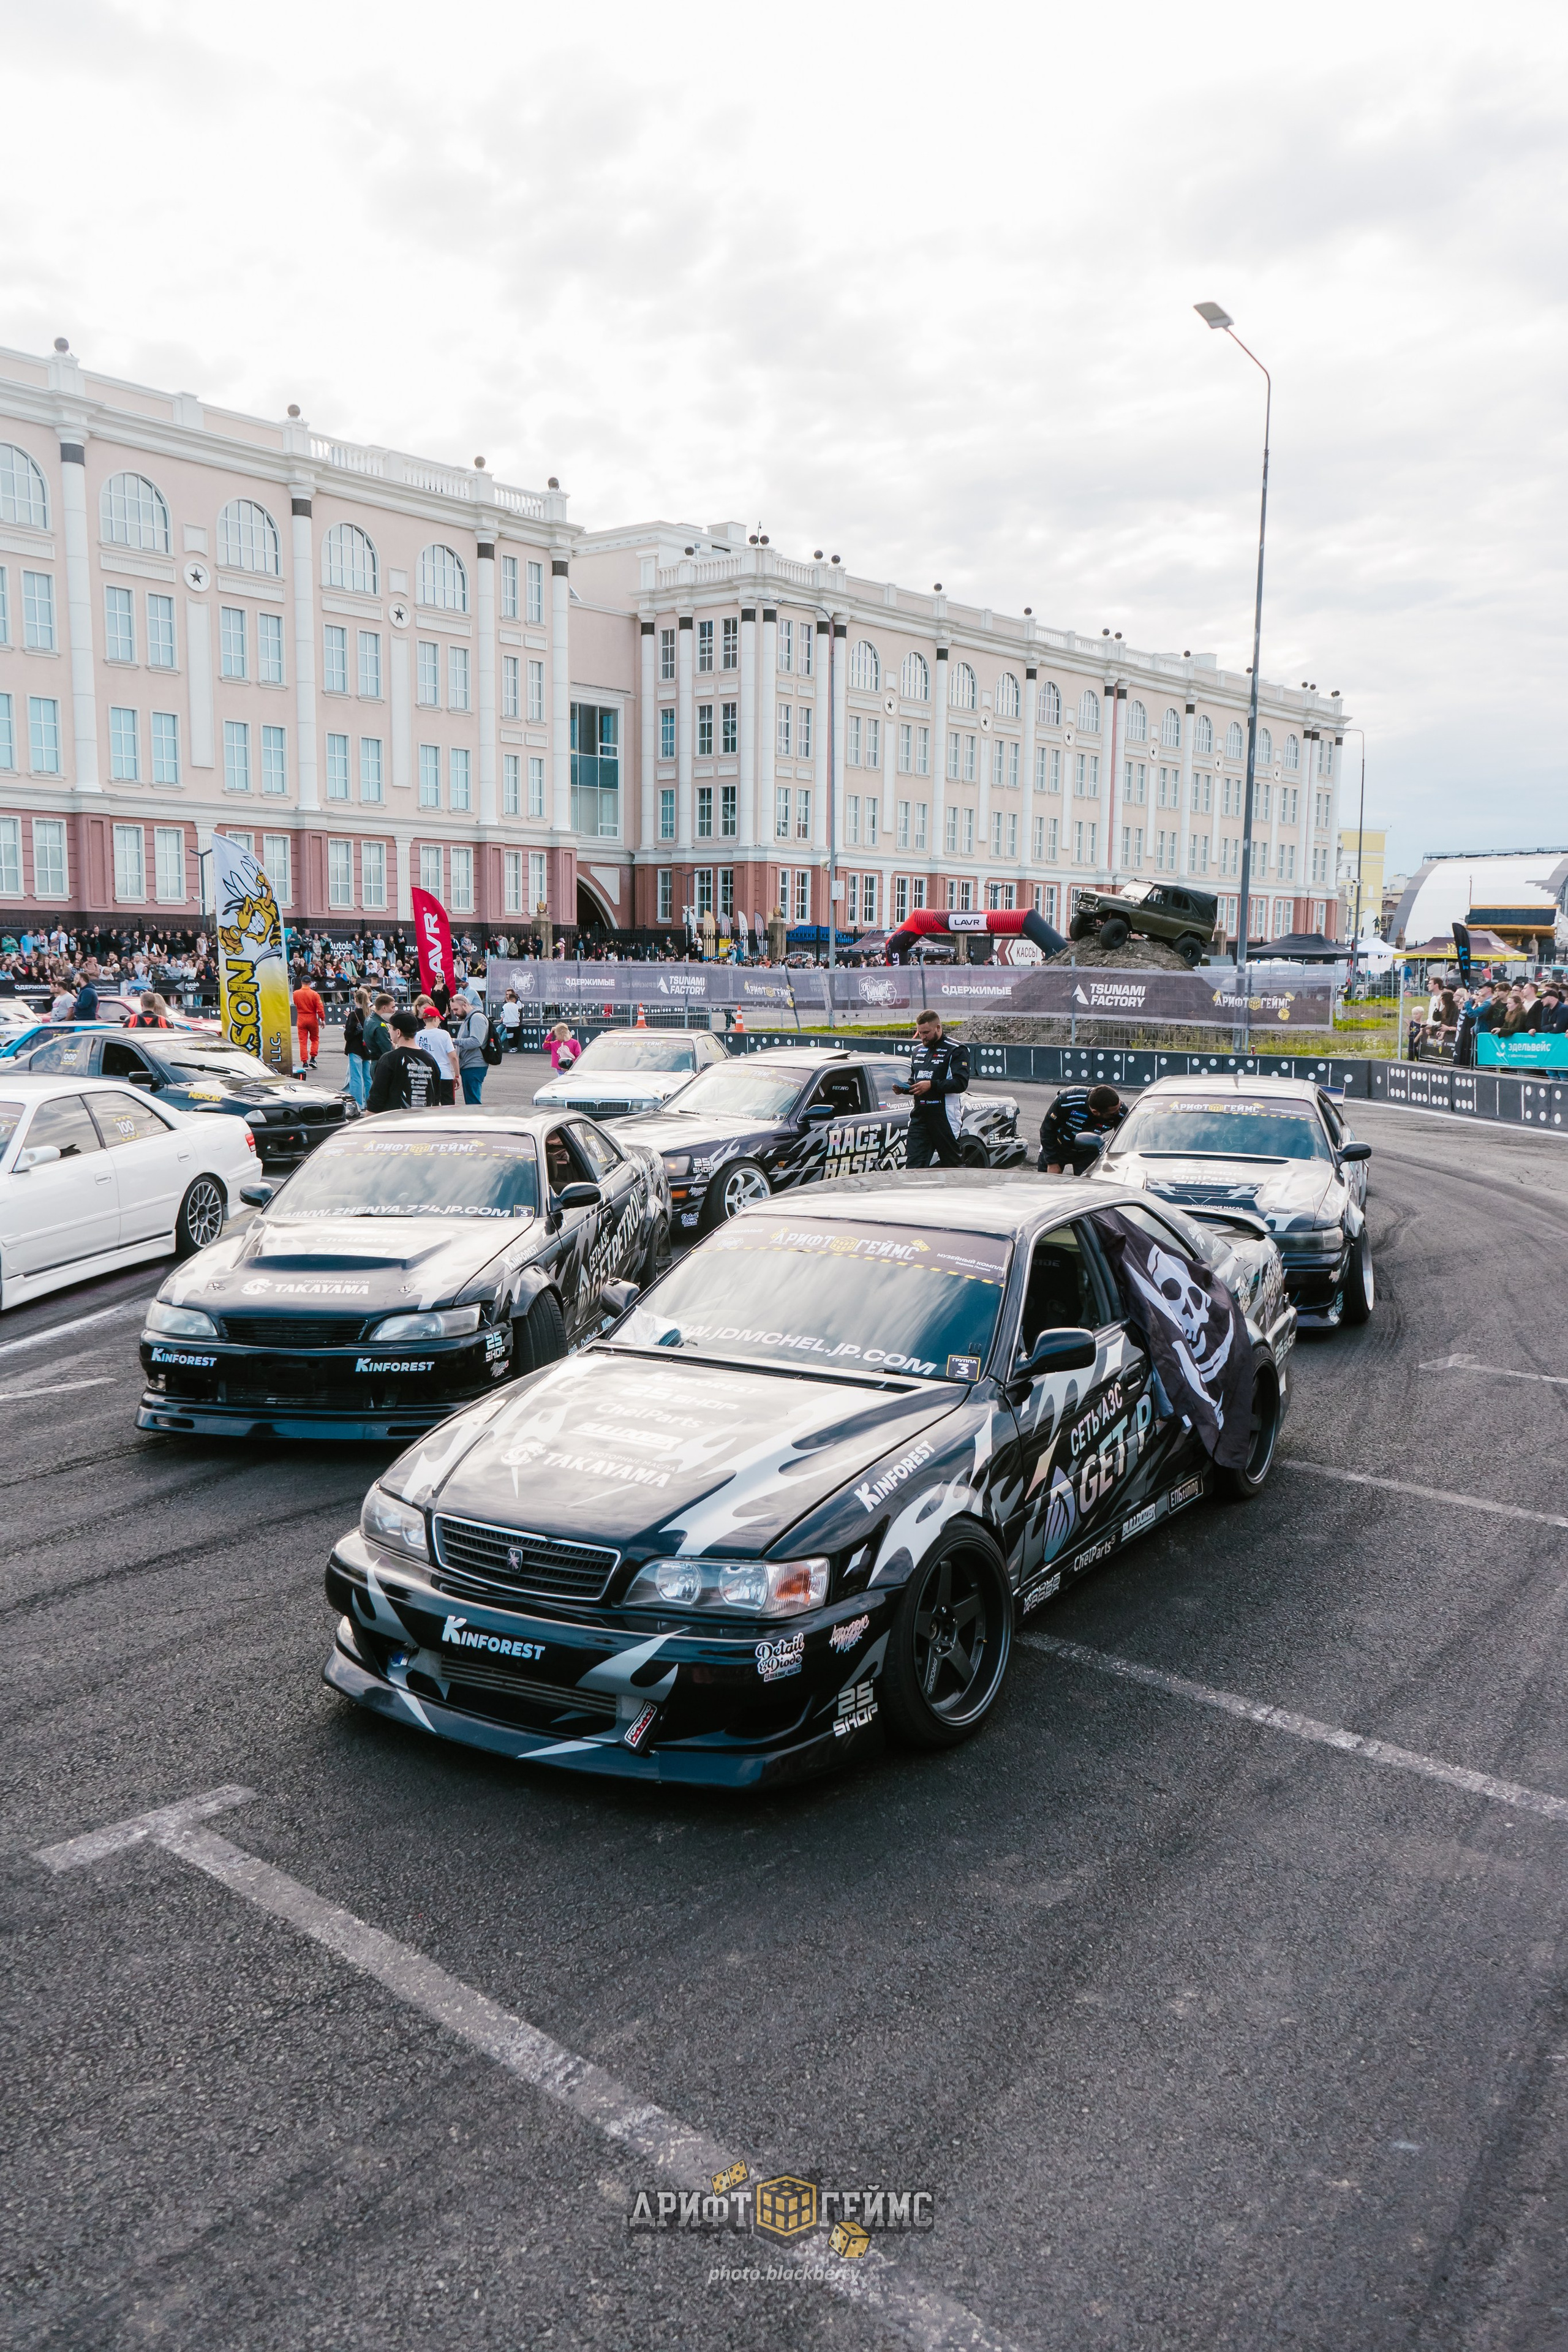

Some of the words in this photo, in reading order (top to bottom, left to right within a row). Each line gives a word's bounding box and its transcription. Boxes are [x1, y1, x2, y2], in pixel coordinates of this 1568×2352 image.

[330, 941, 352, 950] Autola
[423, 913, 445, 984] AVR
[1016, 946, 1038, 957] КАССЫ
[565, 978, 615, 987] ОДЕРЖИМЫЕ
[669, 976, 705, 985] TSUNAMI
[670, 986, 706, 995] FACTORY
[941, 985, 1012, 995] ОДЕРЖИМЫЕ
[1090, 984, 1145, 996] TSUNAMI
[1090, 994, 1145, 1007] FACTORY
[1215, 997, 1249, 1008] ДРИФТ
[1261, 996, 1290, 1009] ГЕЙМС
[270, 1032, 282, 1061] LLC.
[1508, 1041, 1551, 1052] эдельвейс
[1223, 1102, 1260, 1113] ГЕЙМС
[116, 1120, 135, 1133] 100
[366, 1143, 410, 1153] ДРИФТ
[429, 1142, 477, 1152] ГЕЙМС
[827, 1124, 881, 1156] RACE
[693, 1158, 710, 1167] 25
[682, 1212, 699, 1221] Detail
[771, 1233, 835, 1248] ДРИФТ
[855, 1239, 920, 1261] ГЕЙМС
[937, 1252, 976, 1264] МУЗЕЙНЫЙ
[275, 1284, 369, 1294] TAKAYAMA
[486, 1330, 503, 1351] 25
[679, 1324, 937, 1376] W.JDMCHEL.JP.COM
[151, 1348, 217, 1366] KINFOREST
[486, 1346, 505, 1362] SHOP
[355, 1358, 435, 1373] KINFOREST
[956, 1363, 969, 1374] 3
[649, 1371, 763, 1395] KINFOREST
[620, 1384, 668, 1399] 25
[676, 1395, 740, 1411] SHOP
[596, 1403, 704, 1428] ChelParts
[1071, 1409, 1099, 1457] СЕТЬ
[1102, 1382, 1123, 1426] АЗС
[574, 1422, 683, 1450] BULLDOZER
[545, 1452, 671, 1488] TAKAYAMA
[589, 1450, 641, 1465] МОТОРНЫЕ
[643, 1459, 676, 1472] МАСЛА
[1079, 1414, 1128, 1513] GET
[854, 1440, 935, 1513] KINFOREST
[1122, 1503, 1156, 1537] BULLDOZER
[1074, 1539, 1112, 1572] ChelParts
[442, 1615, 545, 1660] KINFOREST
[756, 1634, 804, 1662] Detail
[838, 1679, 874, 1716] 25
[628, 1705, 651, 1740] FORWARD
[633, 1709, 654, 1741] RACING
[833, 1702, 878, 1736] SHOP
